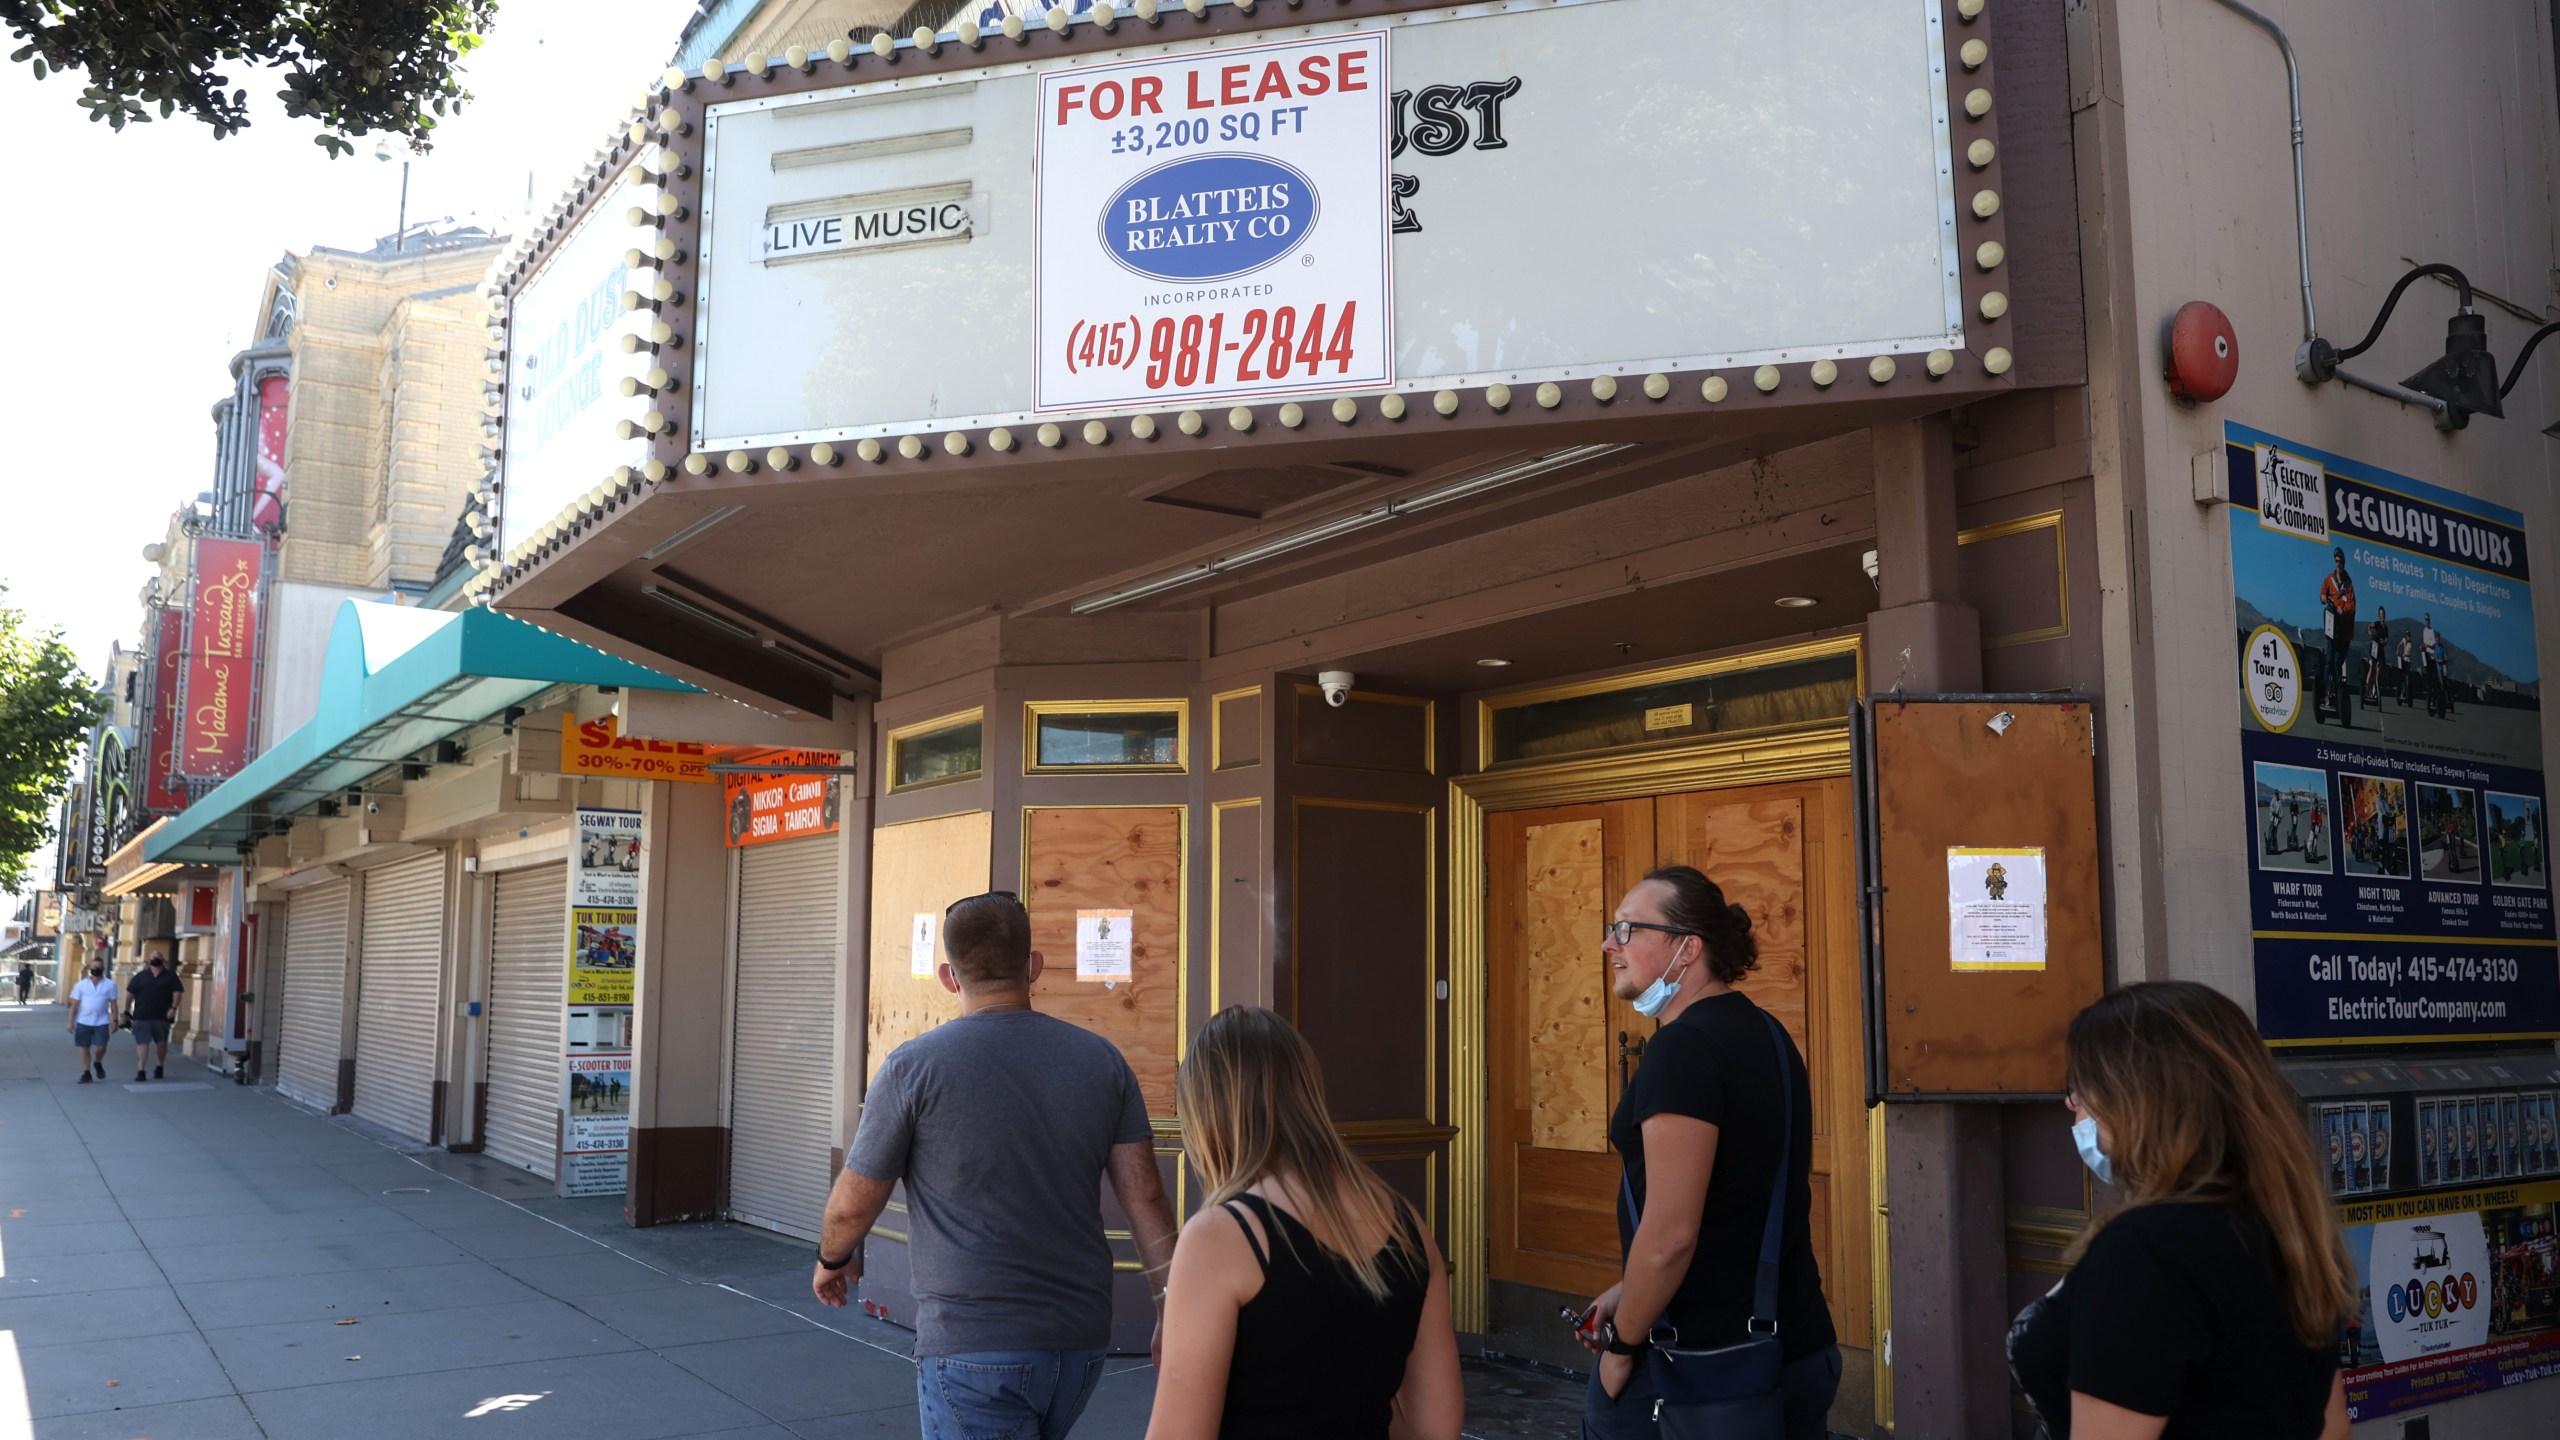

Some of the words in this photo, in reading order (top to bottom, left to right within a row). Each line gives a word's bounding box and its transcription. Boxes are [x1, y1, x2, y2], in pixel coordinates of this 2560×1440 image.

[1057, 75, 1164, 126] FOR
[1187, 50, 1368, 110] LEASE
[1111, 117, 1209, 156] ±3,200
[1220, 111, 1260, 142] SQ
[1271, 105, 1309, 136] FT
[1126, 182, 1290, 224] BLATTEIS
[773, 218, 842, 251] LIVE
[853, 203, 962, 240] MUSIC
[1126, 219, 1241, 252] REALTY
[1247, 213, 1291, 239] CO
[1143, 283, 1274, 307] INCORPORATED
[573, 259, 630, 360] DUST
[1066, 314, 1141, 375] (415)
[1145, 300, 1357, 390] 981-2844
[536, 350, 603, 451] LOUNGE
[2280, 466, 2319, 493] ELECTRIC
[2282, 486, 2305, 509] TOUR
[2283, 508, 2325, 535] COMPANY
[2334, 487, 2439, 547] SEGWAY
[2443, 518, 2513, 568] TOURS
[2353, 548, 2361, 562] 4
[2363, 551, 2390, 571] Great
[2392, 557, 2425, 578] Routes
[2432, 568, 2438, 582] 7
[2441, 570, 2463, 590] Daily
[2464, 576, 2511, 600] Departures
[2368, 576, 2391, 592] Great
[2392, 579, 2404, 594] for
[2405, 584, 2438, 604] Families,
[2439, 592, 2468, 612] Couples
[2469, 600, 2475, 611] &
[2476, 600, 2502, 618] Singles
[203, 571, 250, 669] Tussauds
[236, 592, 247, 639] FRANCISCO
[234, 640, 243, 659] SAN
[2262, 639, 2278, 660] #1
[2253, 659, 2276, 676] Tour
[2277, 667, 2290, 679] on
[195, 663, 230, 754] Madame
[2260, 704, 2288, 716] tripadvisor
[578, 754, 675, 774] 30%-70%
[679, 763, 705, 774] OFF
[2316, 748, 2329, 760] 2.5
[2330, 750, 2347, 762] Hour
[2348, 752, 2389, 768] Fully-Guided
[2390, 758, 2404, 770] Tour
[2405, 760, 2431, 774] includes
[2431, 764, 2443, 775] Fun
[2443, 766, 2466, 780] Segway
[2466, 769, 2490, 783] Training
[753, 786, 783, 812] NIKKOR
[789, 780, 822, 803] Canon
[580, 814, 616, 828] SEGWAY
[752, 814, 779, 838] SIGMA
[784, 805, 821, 832] TAMRON
[586, 894, 635, 905] 415-474-3130
[2272, 882, 2300, 895] WHARF
[2302, 883, 2323, 897] TOUR
[2358, 887, 2380, 900] NIGHT
[2382, 888, 2401, 901] TOUR
[2428, 891, 2461, 905] ADVANCED
[2462, 893, 2480, 906] TOUR
[2492, 895, 2516, 907] GOLDEN
[2517, 897, 2532, 908] GATE
[2532, 898, 2548, 909] PARK
[2271, 911, 2284, 919] North
[2277, 899, 2305, 908] Fisherman's
[576, 912, 593, 923] TUK
[596, 912, 613, 924] TUK
[2309, 954, 2342, 981] Call
[2347, 955, 2403, 987] Today!
[2407, 956, 2518, 982] 415-474-3130
[583, 993, 630, 1002] 415-851-9190
[2328, 996, 2507, 1023] ElectricTourCompany.com
[569, 1060, 611, 1071] E-SCOOTER
[576, 1139, 624, 1149] 415-474-3130
[2347, 1205, 2373, 1222] MOST
[2376, 1203, 2394, 1219] FUN
[2396, 1201, 2415, 1217] YOU
[2417, 1199, 2435, 1214] CAN
[2437, 1196, 2460, 1212] HAVE
[2462, 1194, 2475, 1209] ON
[2476, 1193, 2482, 1207] 3
[2484, 1189, 2519, 1207] WHEELS!
[2391, 1278, 2475, 1318] LUCKY
[2419, 1321, 2434, 1333] TUK
[2435, 1319, 2449, 1330] TUK
[2348, 1390, 2369, 1402] Tours
[2410, 1376, 2434, 1389] Private
[2434, 1372, 2446, 1383] VIP
[2446, 1369, 2465, 1381] Tours
[2347, 1406, 2358, 1419] 90
